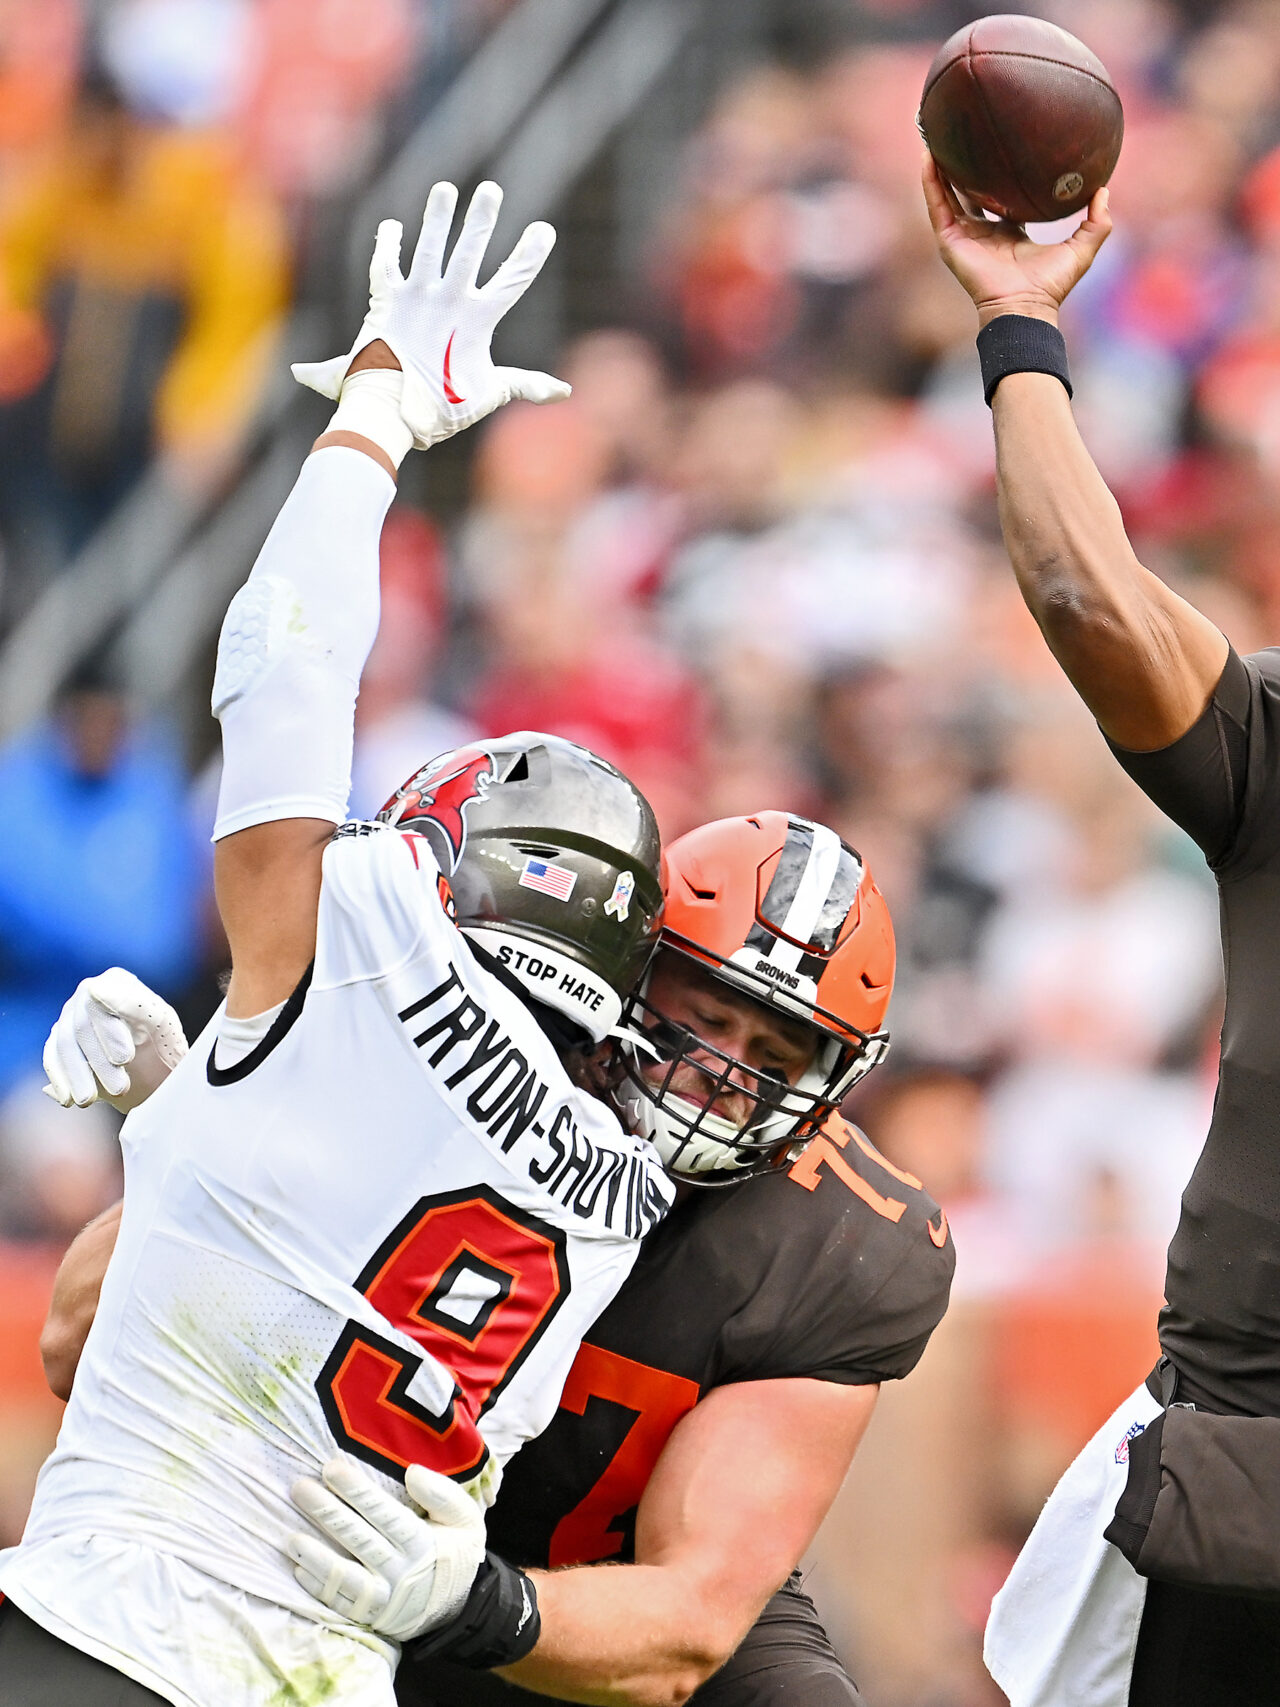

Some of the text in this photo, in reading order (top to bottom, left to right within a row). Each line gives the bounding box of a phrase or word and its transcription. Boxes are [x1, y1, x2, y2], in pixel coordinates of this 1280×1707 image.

[496, 945, 605, 1012] STOP HATE
[754, 959, 800, 990] BROWNS
[787, 1107, 924, 1224] 77
[314, 1182, 572, 1484] 9
[548, 1340, 701, 1568] 7
